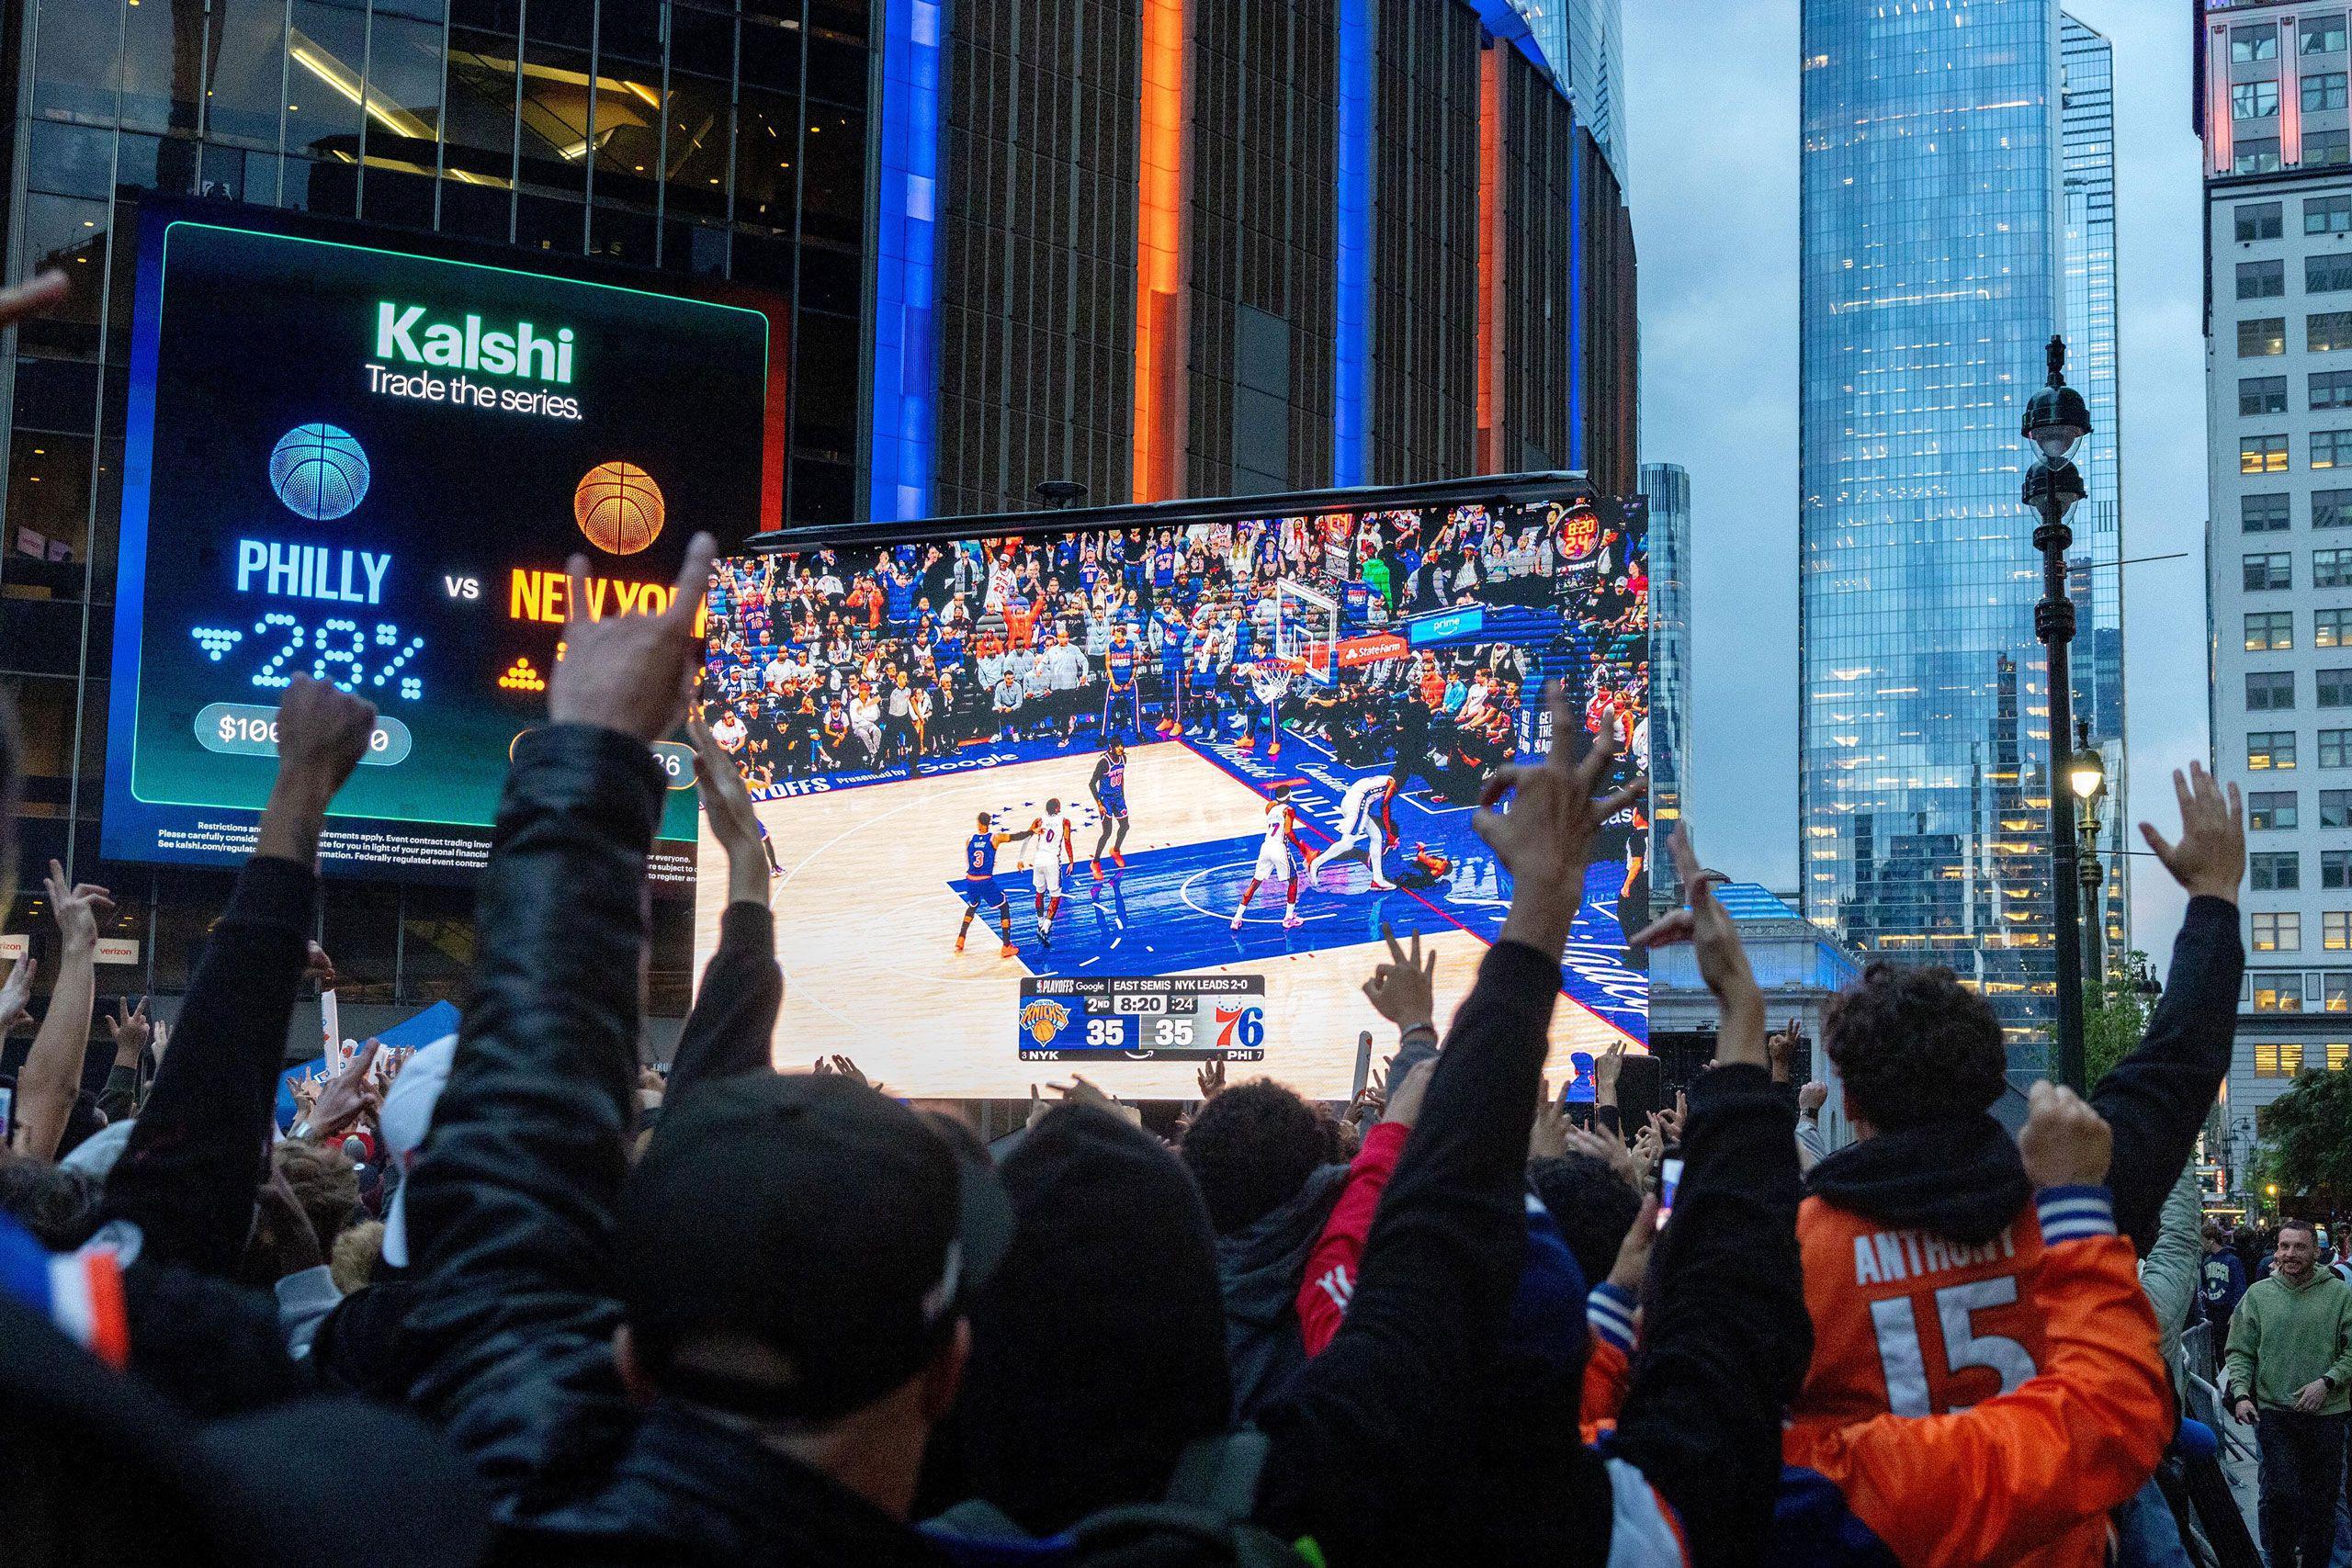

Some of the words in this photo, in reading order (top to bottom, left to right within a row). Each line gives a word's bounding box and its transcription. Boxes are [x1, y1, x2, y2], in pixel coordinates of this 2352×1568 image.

[377, 301, 574, 383] Kalshi
[365, 364, 446, 400] Trade
[449, 375, 496, 407] the
[501, 388, 582, 420] series.
[1568, 519, 1594, 536] 8:20
[1565, 535, 1589, 555] 24
[237, 538, 391, 604] PHILLY
[1433, 616, 1461, 631] prime
[252, 613, 424, 700] 28%
[1539, 711, 1553, 724] GET
[752, 777, 831, 801] YOFFS
[198, 821, 248, 832] Restrictions
[360, 833, 386, 842] apply.
[386, 834, 409, 844] Event
[410, 837, 444, 847] contract
[444, 839, 473, 850] trading
[1046, 829, 1055, 843] 0
[158, 829, 187, 839] Please
[187, 831, 224, 842] carefully
[225, 833, 259, 843] conside
[333, 841, 345, 850] for
[346, 844, 361, 852] you
[362, 842, 370, 851] in
[371, 843, 390, 855] light
[391, 844, 401, 852] of
[401, 848, 420, 856] your
[420, 848, 455, 857] personal
[456, 850, 489, 858] financial
[657, 863, 684, 873] subject
[158, 840, 175, 848] See
[175, 840, 258, 853] kalshi.com/regulato
[355, 852, 391, 863] Federally
[393, 855, 431, 864] regulated
[657, 874, 685, 882] register
[973, 850, 984, 868] 3
[0, 942, 21, 951] rizon
[100, 947, 132, 956] verizon
[1044, 979, 1074, 993] PLAYOFFS
[1076, 981, 1104, 992] Google
[1114, 980, 1138, 991] EAST
[1140, 979, 1171, 991] SEMIS
[1174, 979, 1196, 990] NYK
[1197, 979, 1229, 990] LEADS
[1230, 979, 1248, 989] 2-0
[1022, 1004, 1067, 1026] KNICKS
[1087, 998, 1110, 1012] 2ND
[1120, 997, 1161, 1012] 8:20
[1171, 998, 1193, 1010] :24
[1086, 1019, 1125, 1046] 35
[1154, 1019, 1193, 1046] 35
[1216, 1007, 1264, 1047] 76
[1029, 1051, 1059, 1060] NYK
[1227, 1051, 1252, 1060] PHI
[1257, 1051, 1262, 1059] 7
[1870, 1274, 2038, 1419] 15
